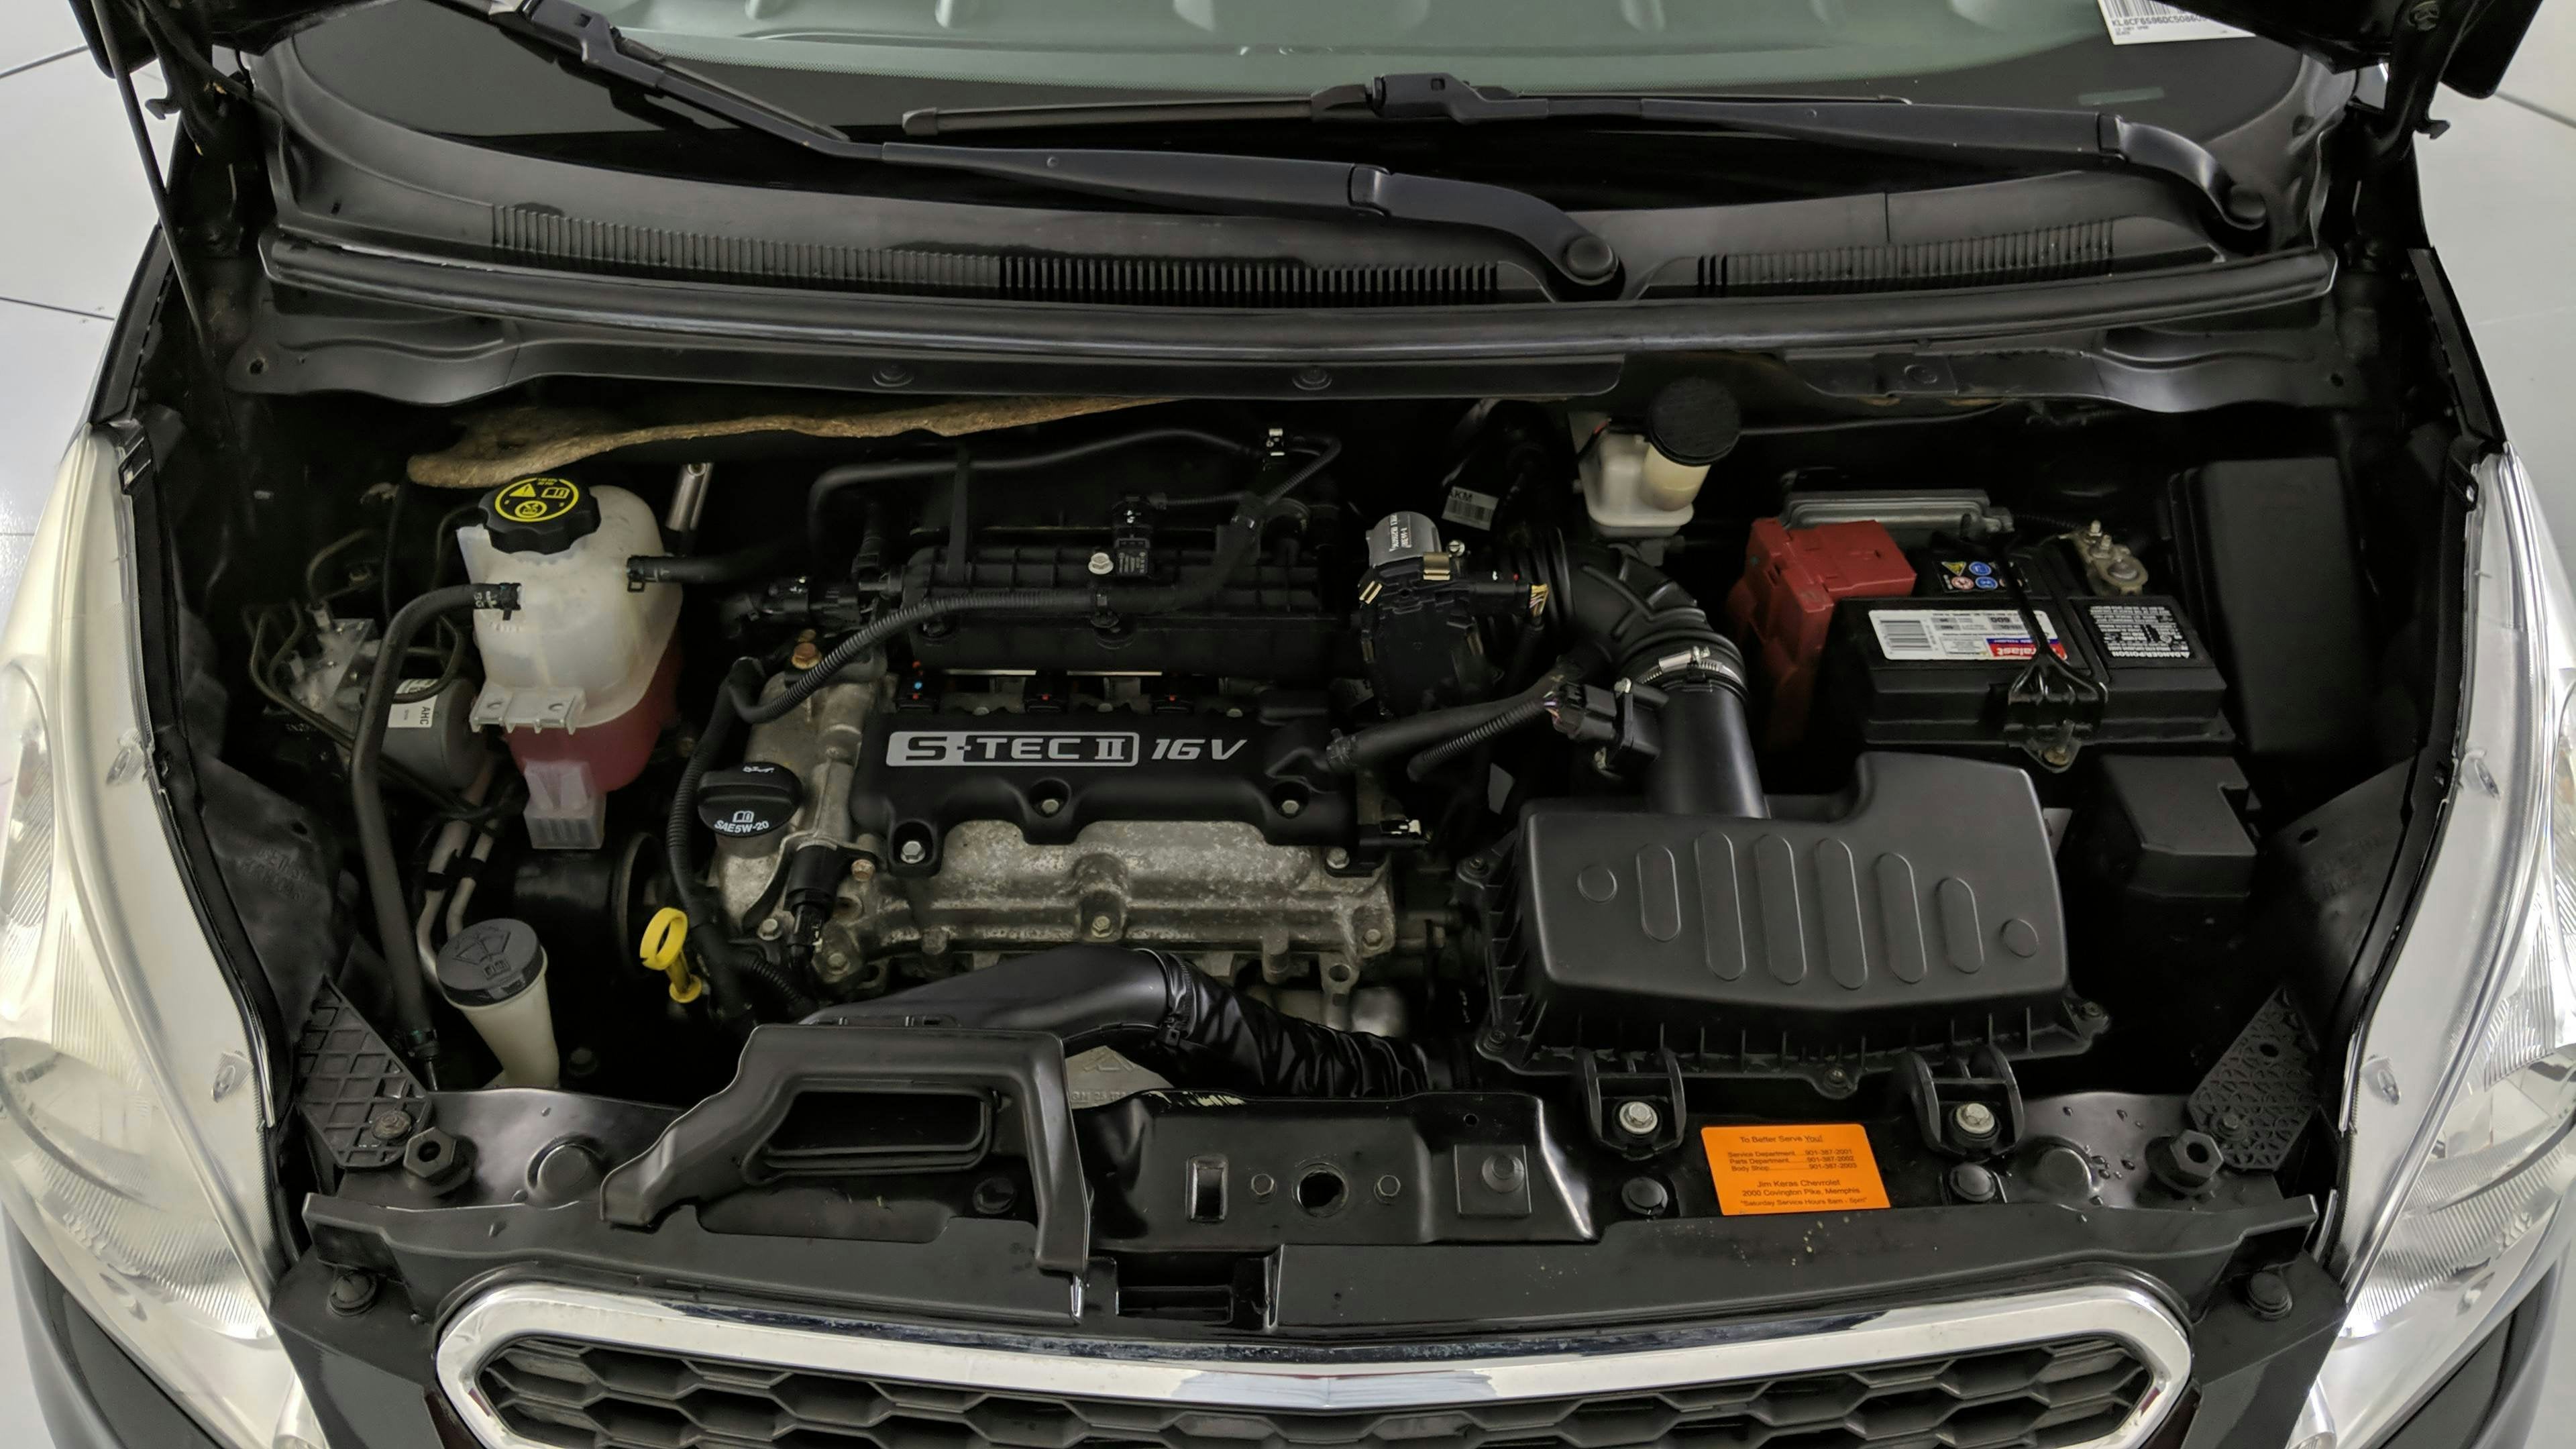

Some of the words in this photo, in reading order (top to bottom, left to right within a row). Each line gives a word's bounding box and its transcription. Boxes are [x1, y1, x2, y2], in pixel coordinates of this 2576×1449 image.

[419, 706, 431, 725] AHC
[1093, 738, 1126, 760] II
[1150, 739, 1248, 760] 16V
[1752, 1135, 1776, 1143] Better
[1800, 1179, 1841, 1187] Chevrolet
[1763, 1189, 1803, 1197] Covington
[1825, 1186, 1861, 1195] Memphis
